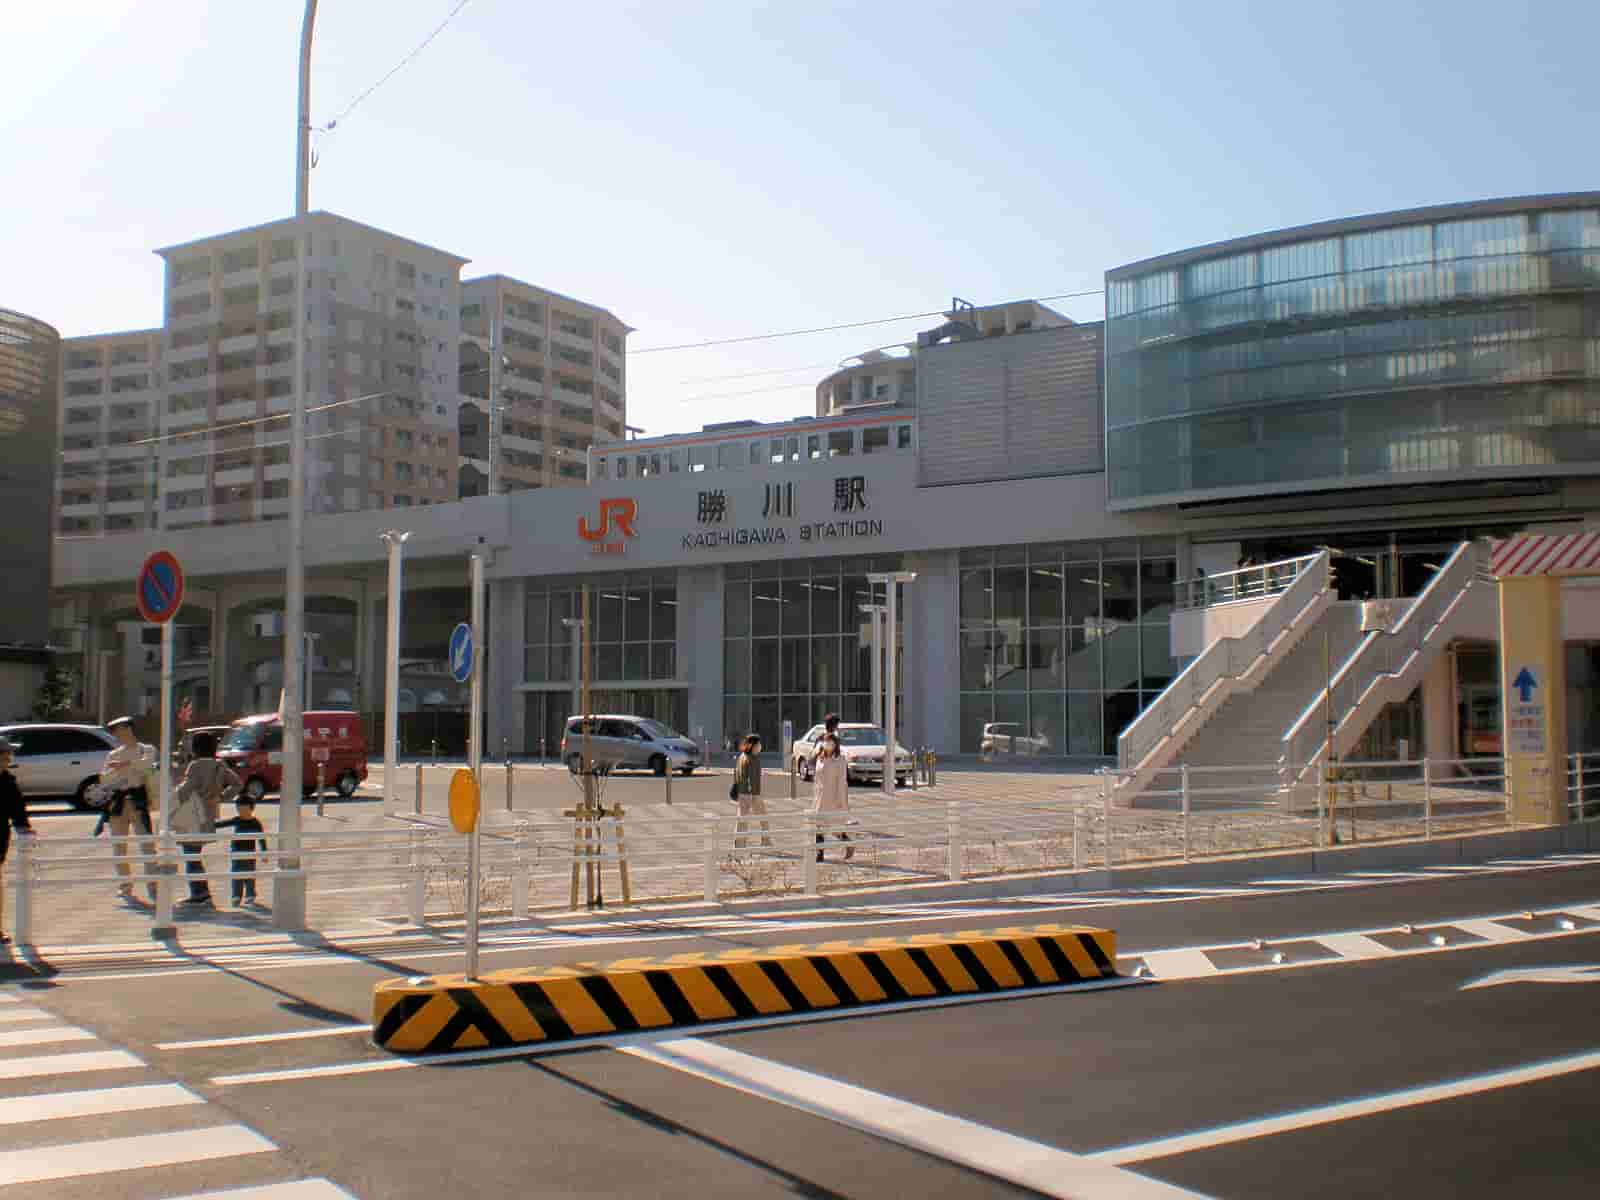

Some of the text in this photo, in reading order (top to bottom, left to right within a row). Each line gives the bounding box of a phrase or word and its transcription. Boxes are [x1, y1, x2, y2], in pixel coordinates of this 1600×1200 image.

[578, 498, 637, 541] JR
[697, 476, 866, 523] 勝川駅
[682, 519, 882, 550] KACHIGAWA STATION
